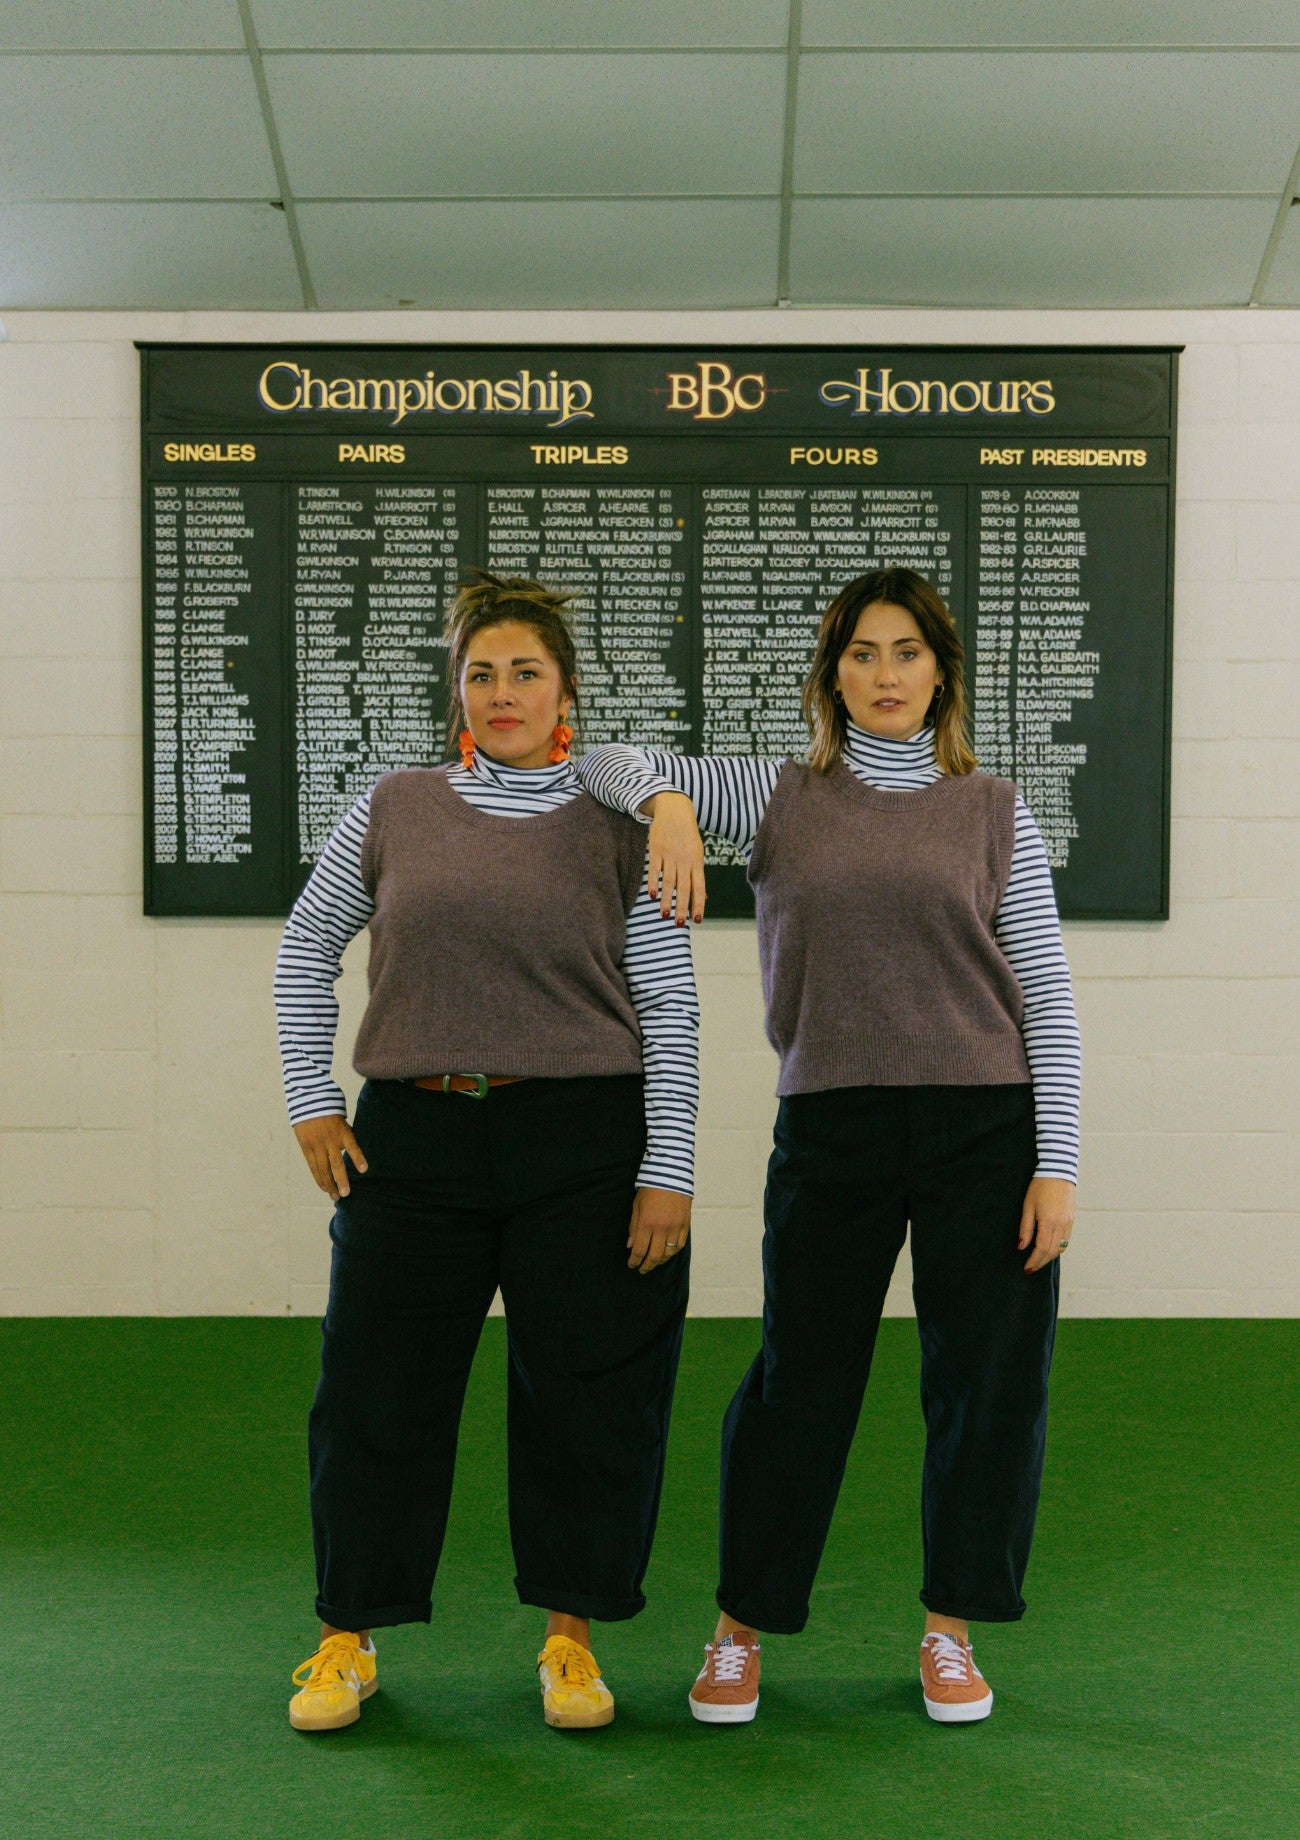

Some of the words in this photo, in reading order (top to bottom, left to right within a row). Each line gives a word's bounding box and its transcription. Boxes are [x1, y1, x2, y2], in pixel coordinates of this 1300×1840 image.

[259, 362, 594, 426] Championship
[666, 362, 766, 420] BBC
[819, 368, 1055, 415] Honours
[165, 444, 255, 463] SINGLES
[339, 445, 405, 463] PAIRS
[531, 446, 628, 464] TRIPLES
[790, 448, 878, 465] FOURS
[980, 449, 1023, 466] PAST
[1033, 449, 1146, 466] PRESIDENTS
[186, 515, 245, 524] B.CHAPMAN
[183, 596, 238, 606] G.ROBERTS
[703, 699, 723, 708] TED
